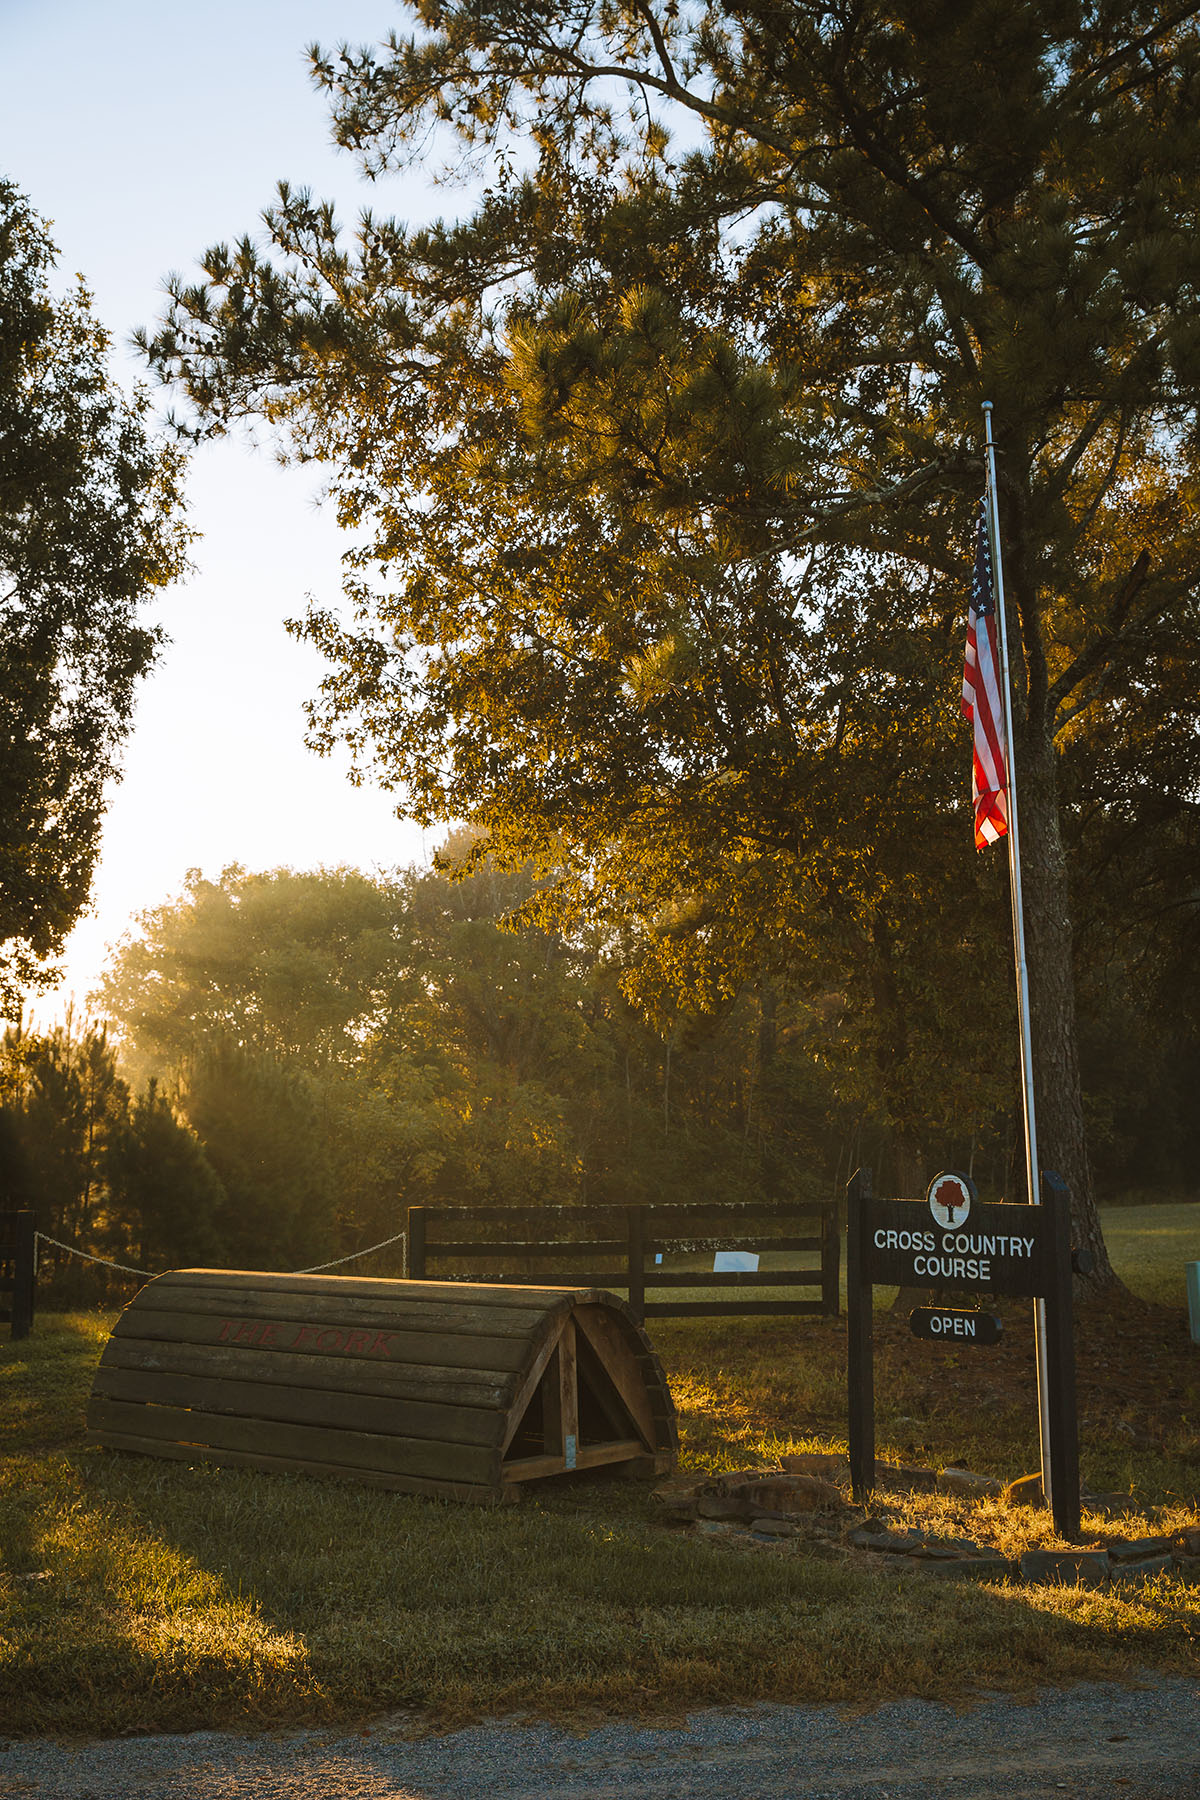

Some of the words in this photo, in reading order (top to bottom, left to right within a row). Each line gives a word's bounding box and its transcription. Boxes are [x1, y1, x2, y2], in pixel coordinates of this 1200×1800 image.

[874, 1229, 936, 1252] CROSS
[942, 1233, 1035, 1258] COUNTRY
[913, 1255, 991, 1280] COURSE
[217, 1319, 283, 1345] THE
[291, 1327, 399, 1355] FORK
[930, 1316, 976, 1337] OPEN
